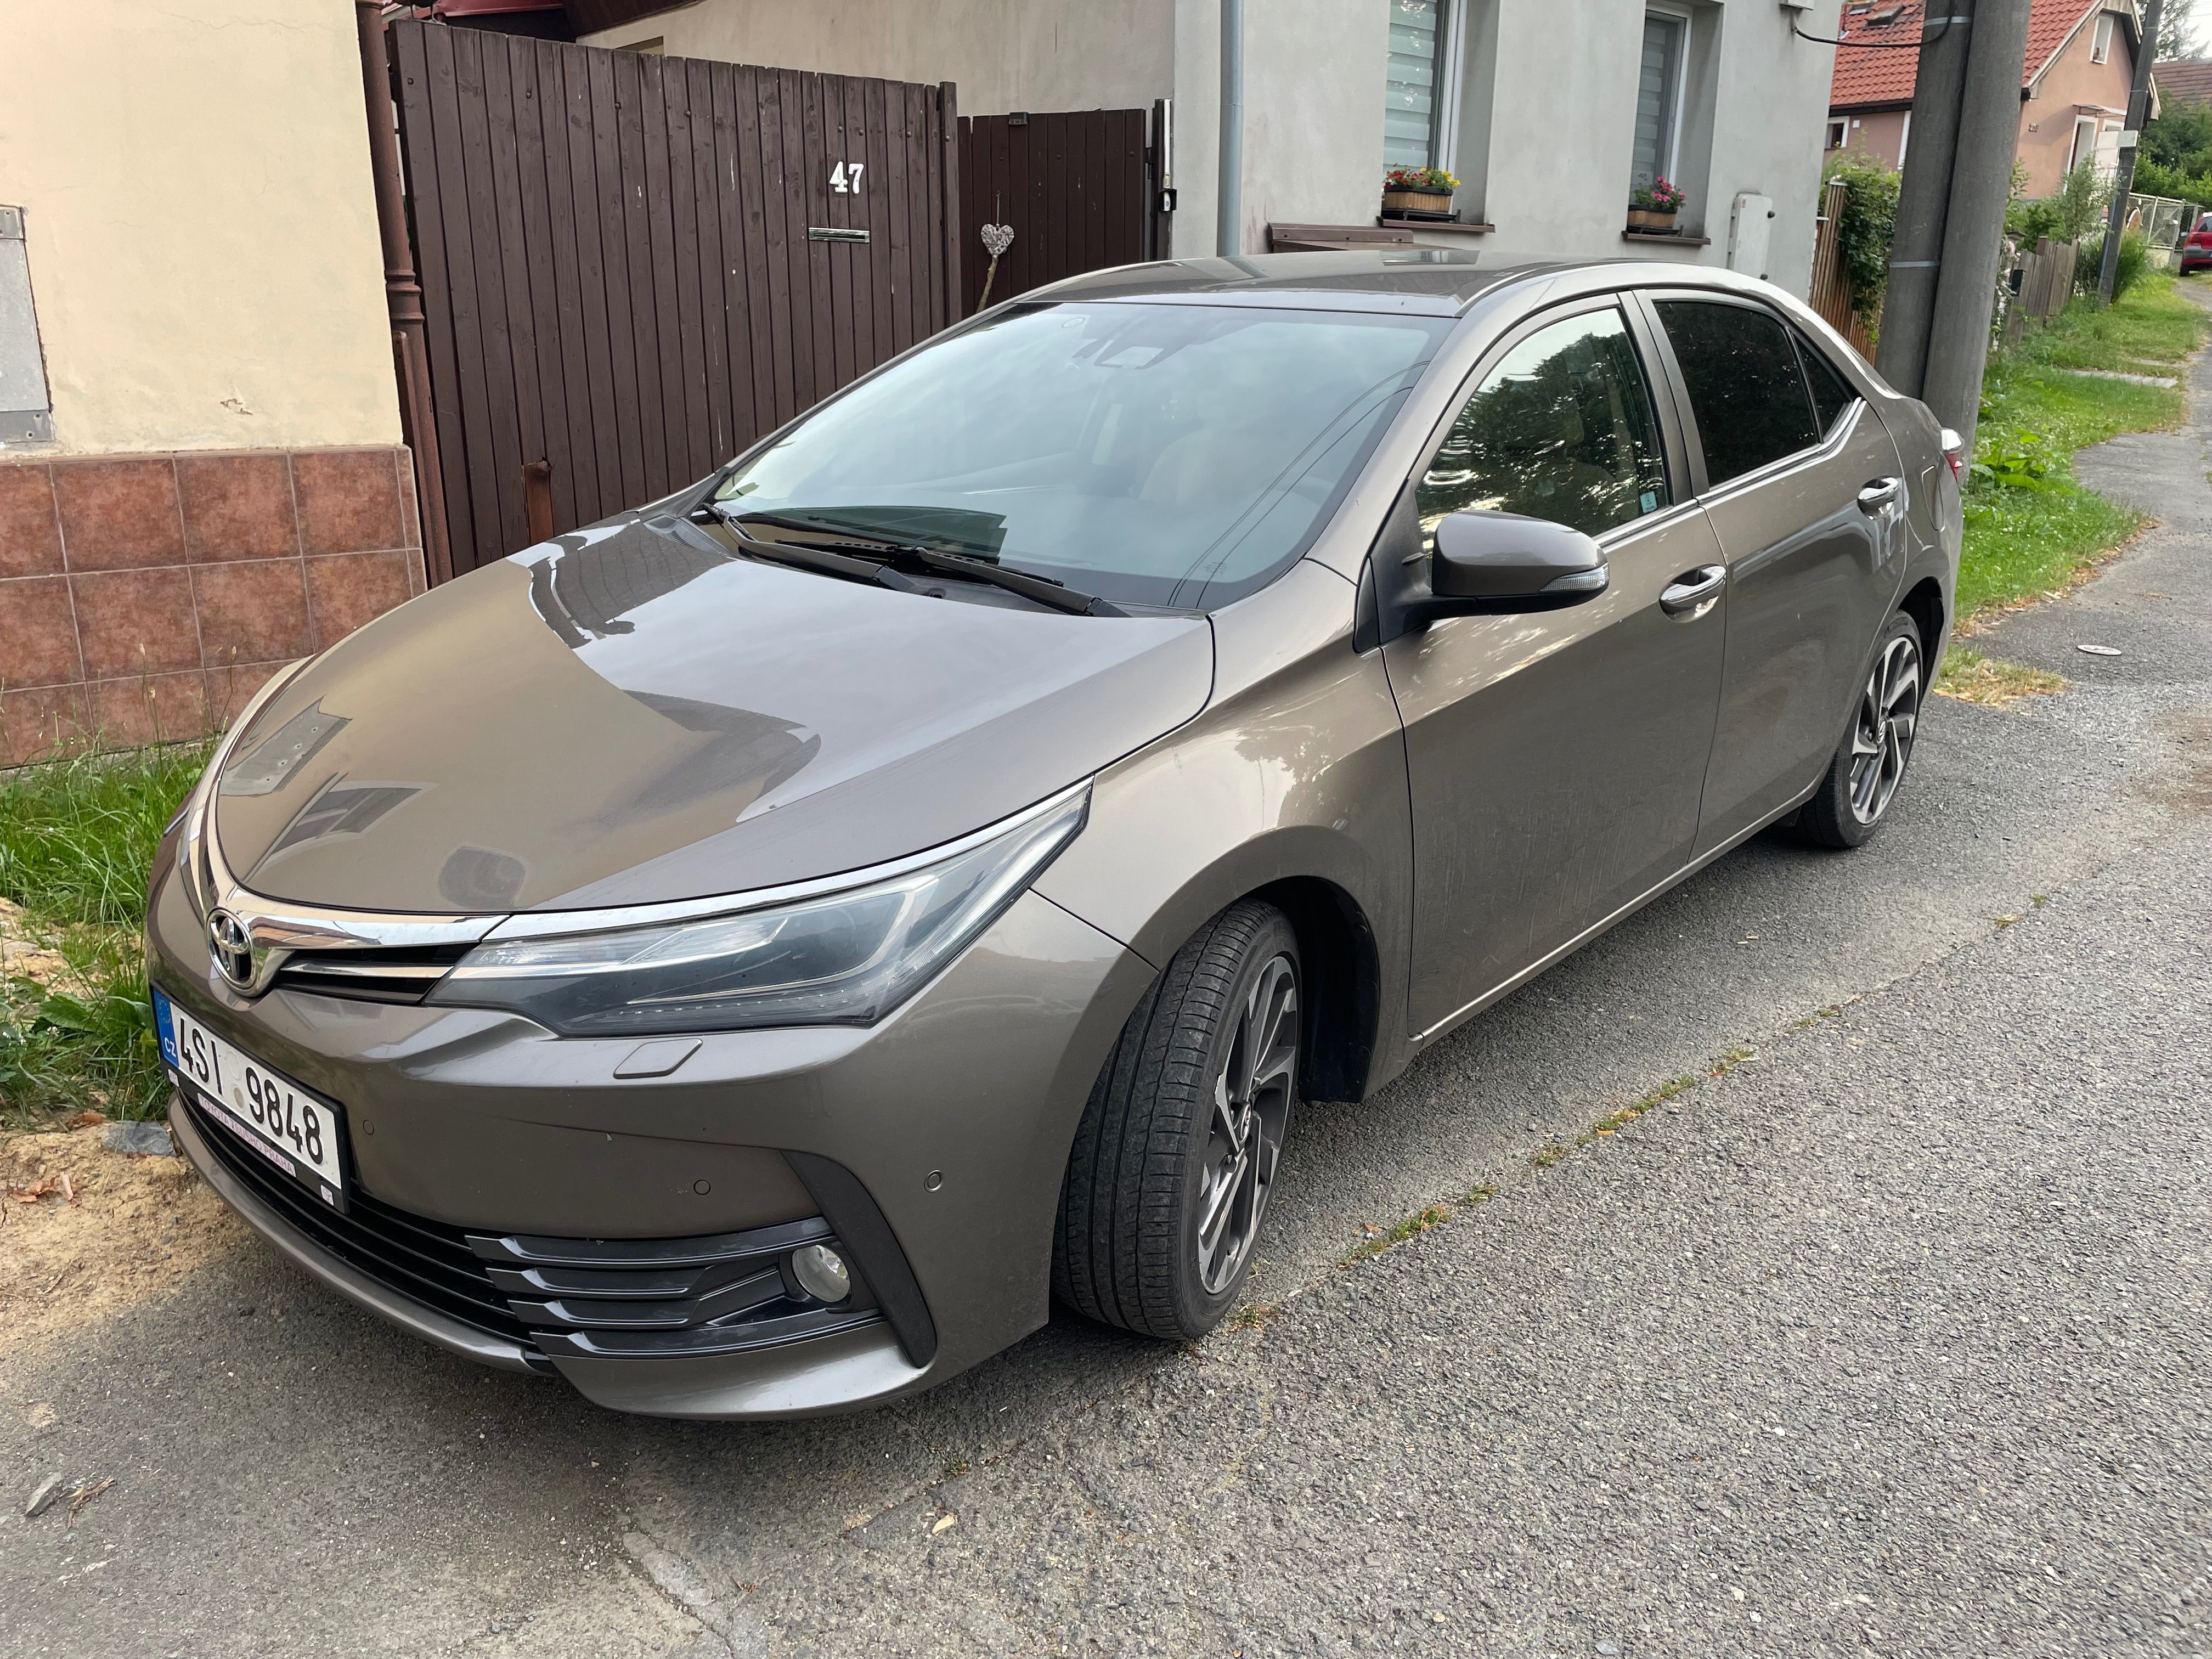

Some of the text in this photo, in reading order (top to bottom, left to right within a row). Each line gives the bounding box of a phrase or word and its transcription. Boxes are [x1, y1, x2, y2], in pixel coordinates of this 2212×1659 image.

[829, 161, 864, 194] 47
[165, 1037, 177, 1058] CZ
[180, 1018, 324, 1165] 4SI 9848
[199, 1097, 229, 1124] TOYOTA
[263, 1143, 293, 1173] PRAHA
